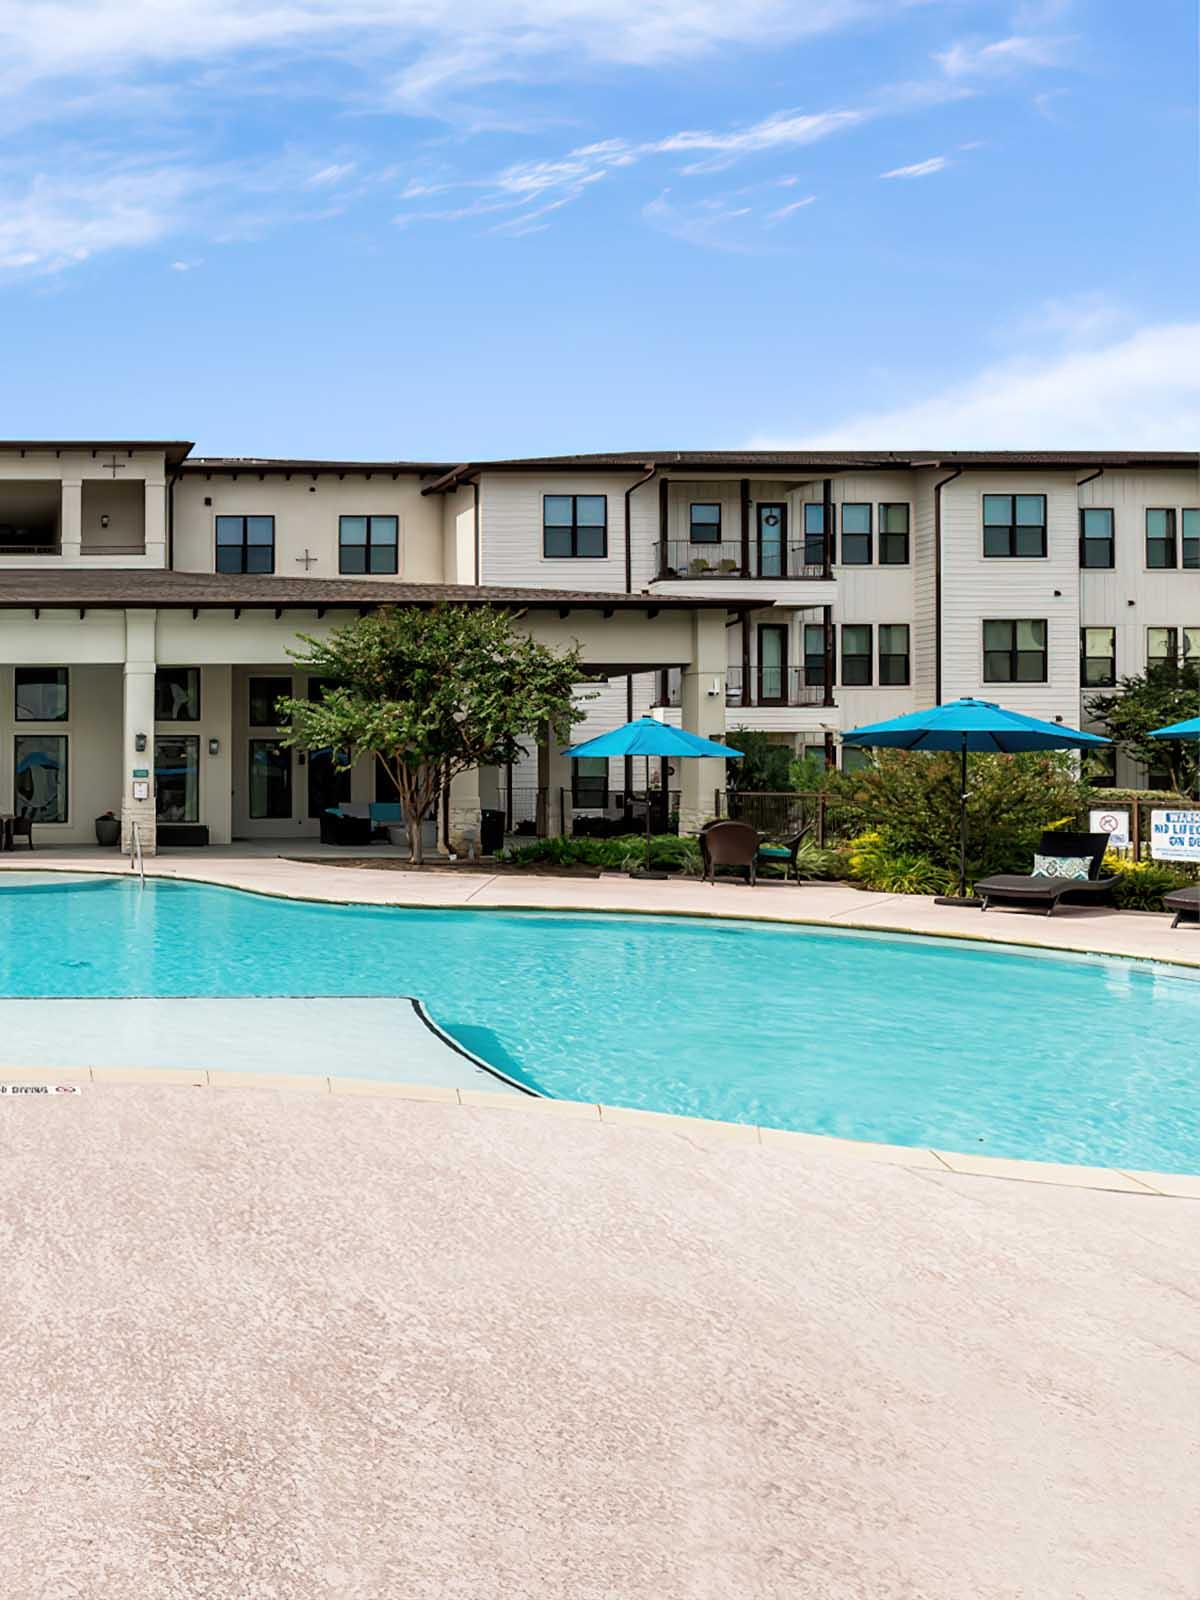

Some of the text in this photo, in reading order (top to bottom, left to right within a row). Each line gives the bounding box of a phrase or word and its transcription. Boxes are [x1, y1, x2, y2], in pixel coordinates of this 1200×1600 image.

[1154, 824, 1169, 833] NO
[1169, 837, 1185, 846] ON
[12, 1086, 48, 1094] DIVING
